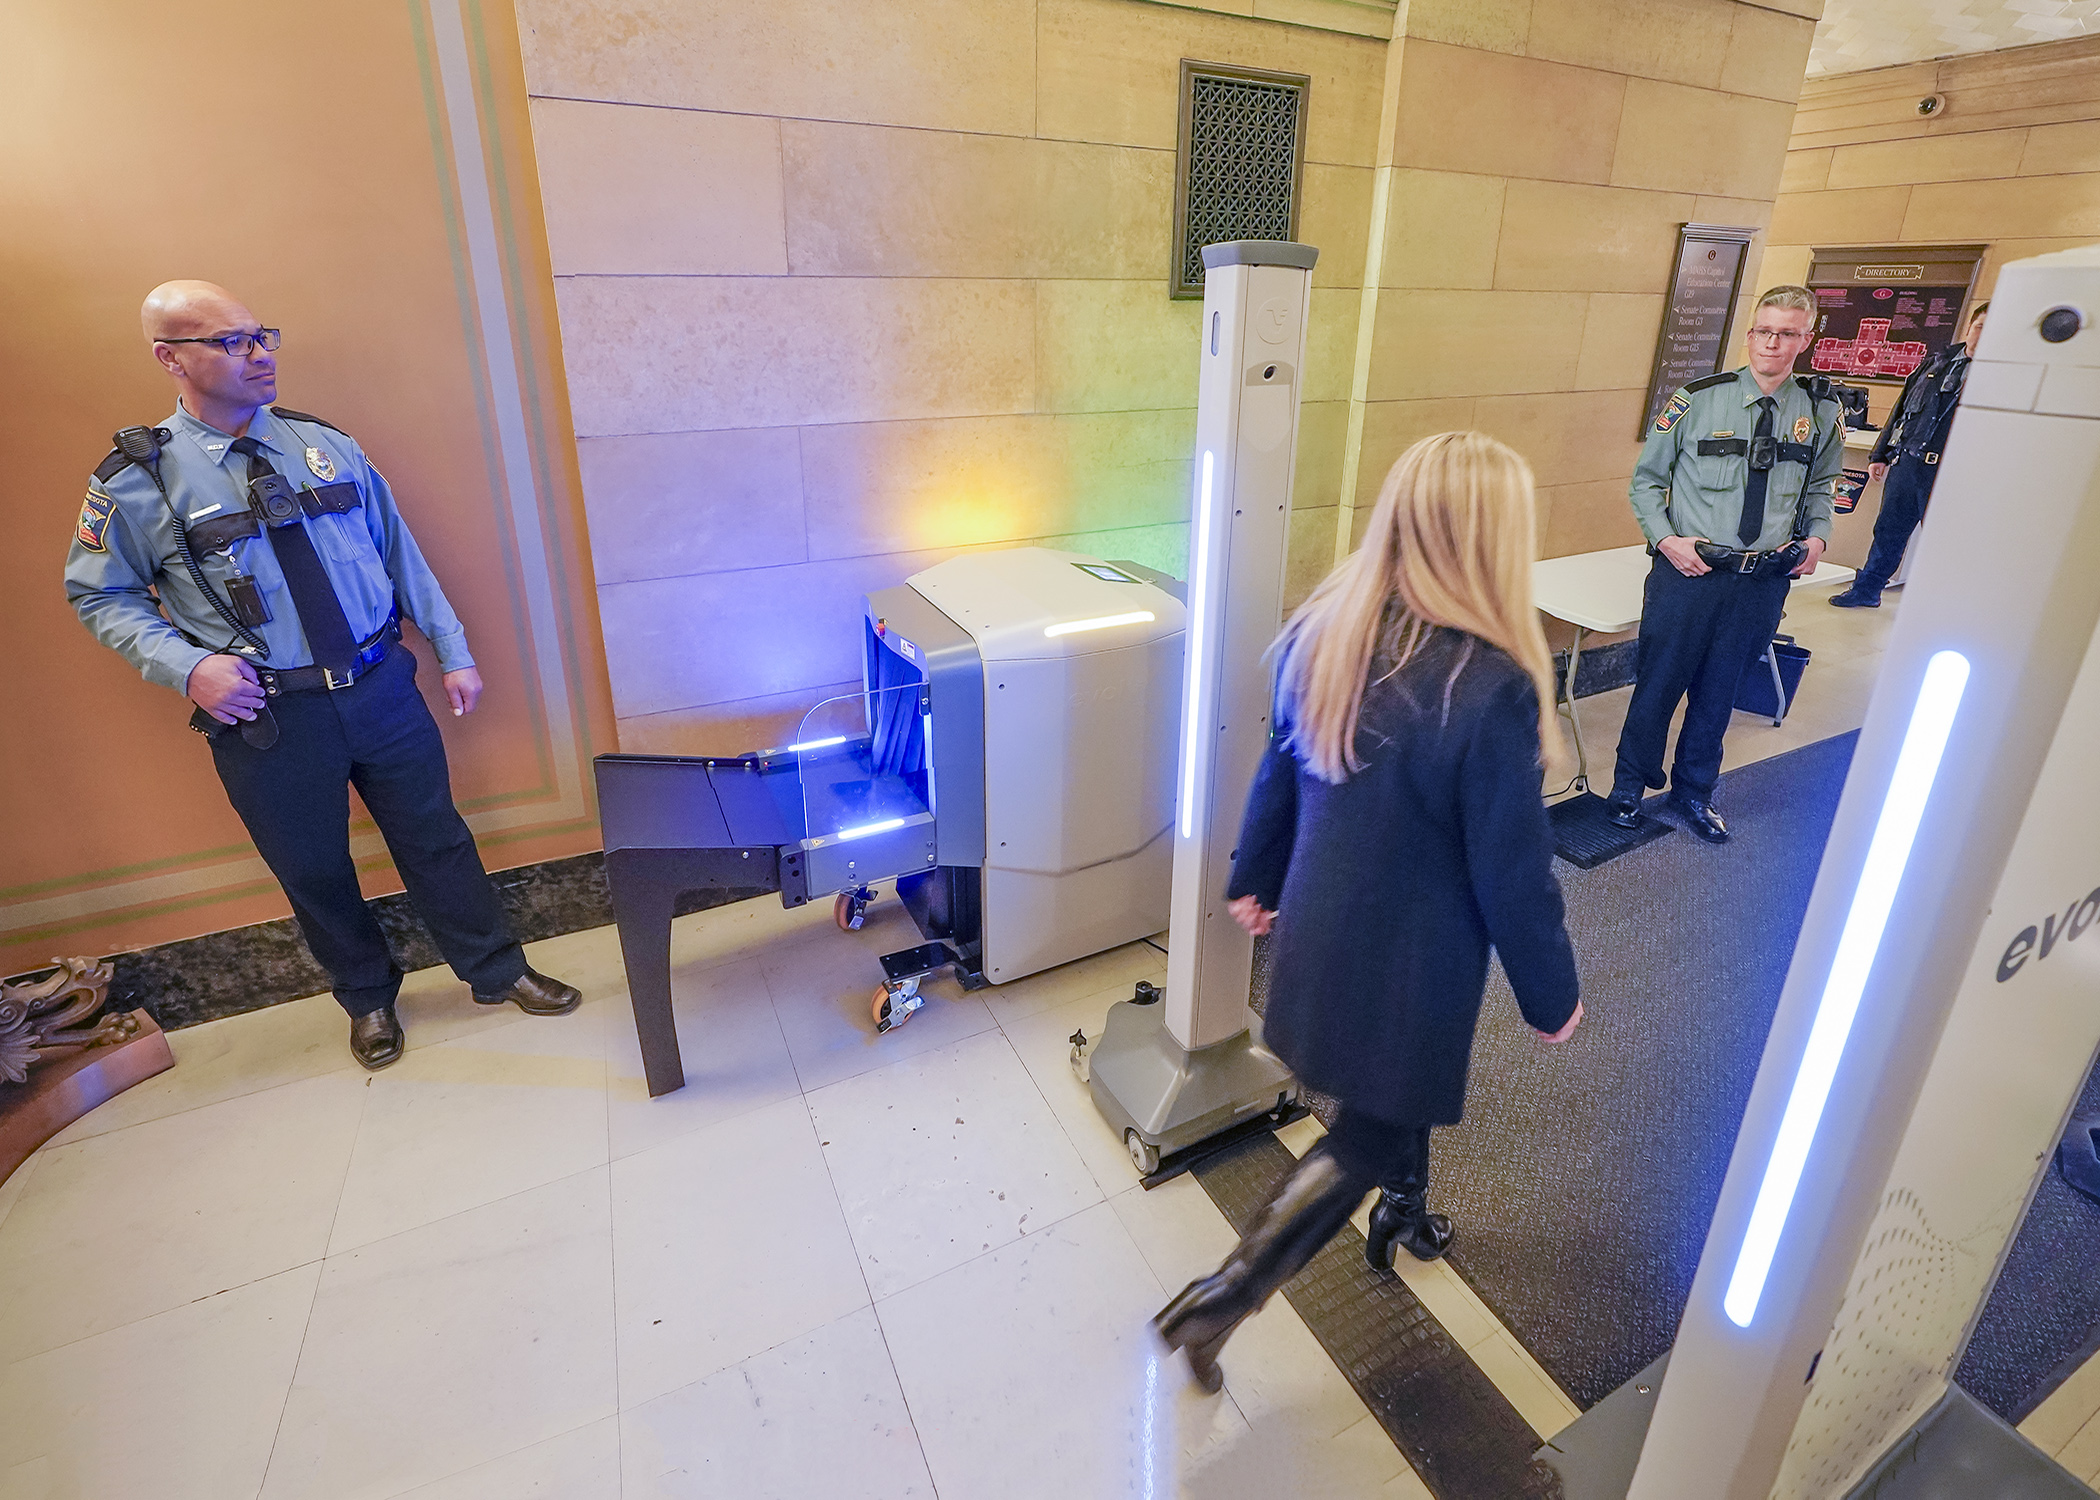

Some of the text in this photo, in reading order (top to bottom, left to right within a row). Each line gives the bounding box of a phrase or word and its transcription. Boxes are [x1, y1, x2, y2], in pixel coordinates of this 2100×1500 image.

[1707, 265, 1726, 277] Capitol
[1865, 268, 1912, 276] DIRECTORY
[1686, 278, 1731, 288] Education Center
[1680, 305, 1727, 314] Senate Committee
[1678, 317, 1695, 326] Room
[1675, 332, 1721, 341] Senate Committee
[1672, 343, 1689, 352] Room
[1669, 359, 1715, 367] Senate Committee
[1667, 370, 1684, 378] Room
[1996, 886, 2100, 983] evo
